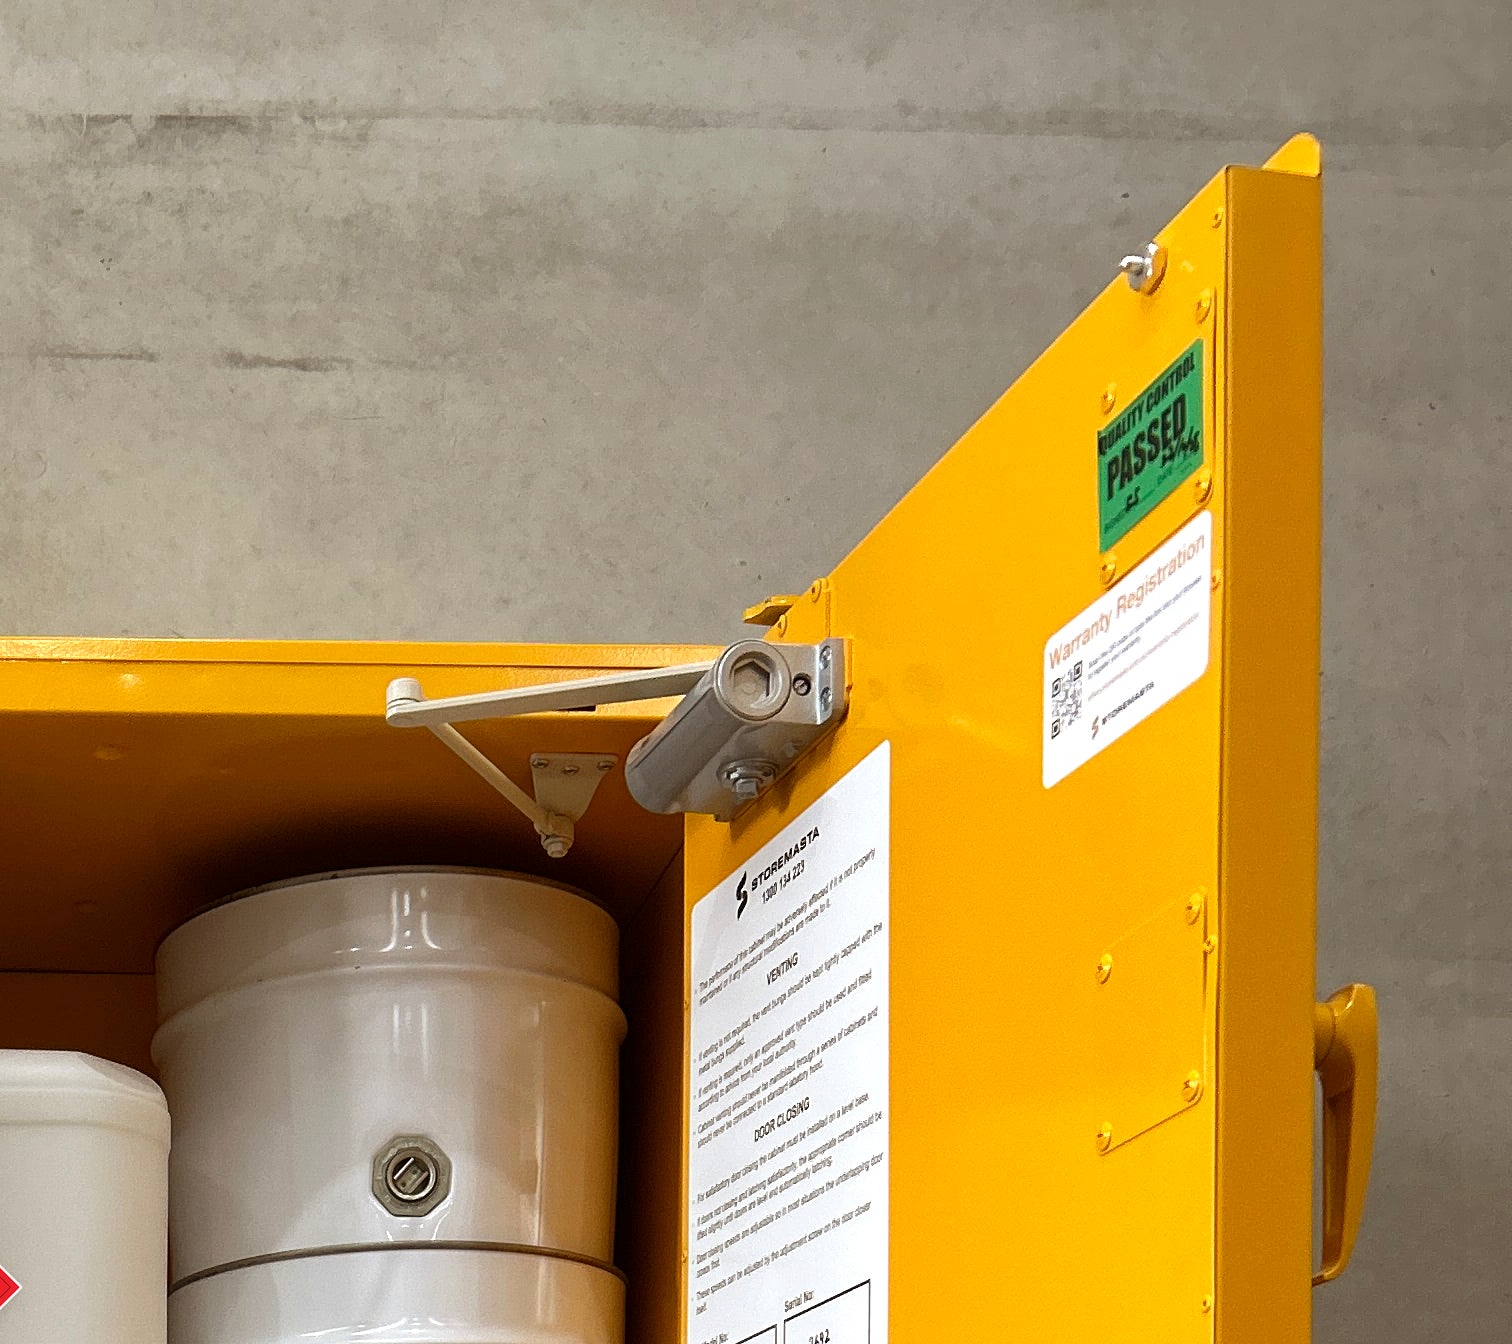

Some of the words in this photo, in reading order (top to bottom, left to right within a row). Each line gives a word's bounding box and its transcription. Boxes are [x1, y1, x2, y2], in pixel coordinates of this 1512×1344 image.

[1146, 352, 1195, 413] CONTROL
[1107, 392, 1186, 500] PASSED
[1049, 601, 1112, 669] Warranty
[1116, 533, 1204, 620] Registration
[751, 826, 820, 891] STOREMASTA
